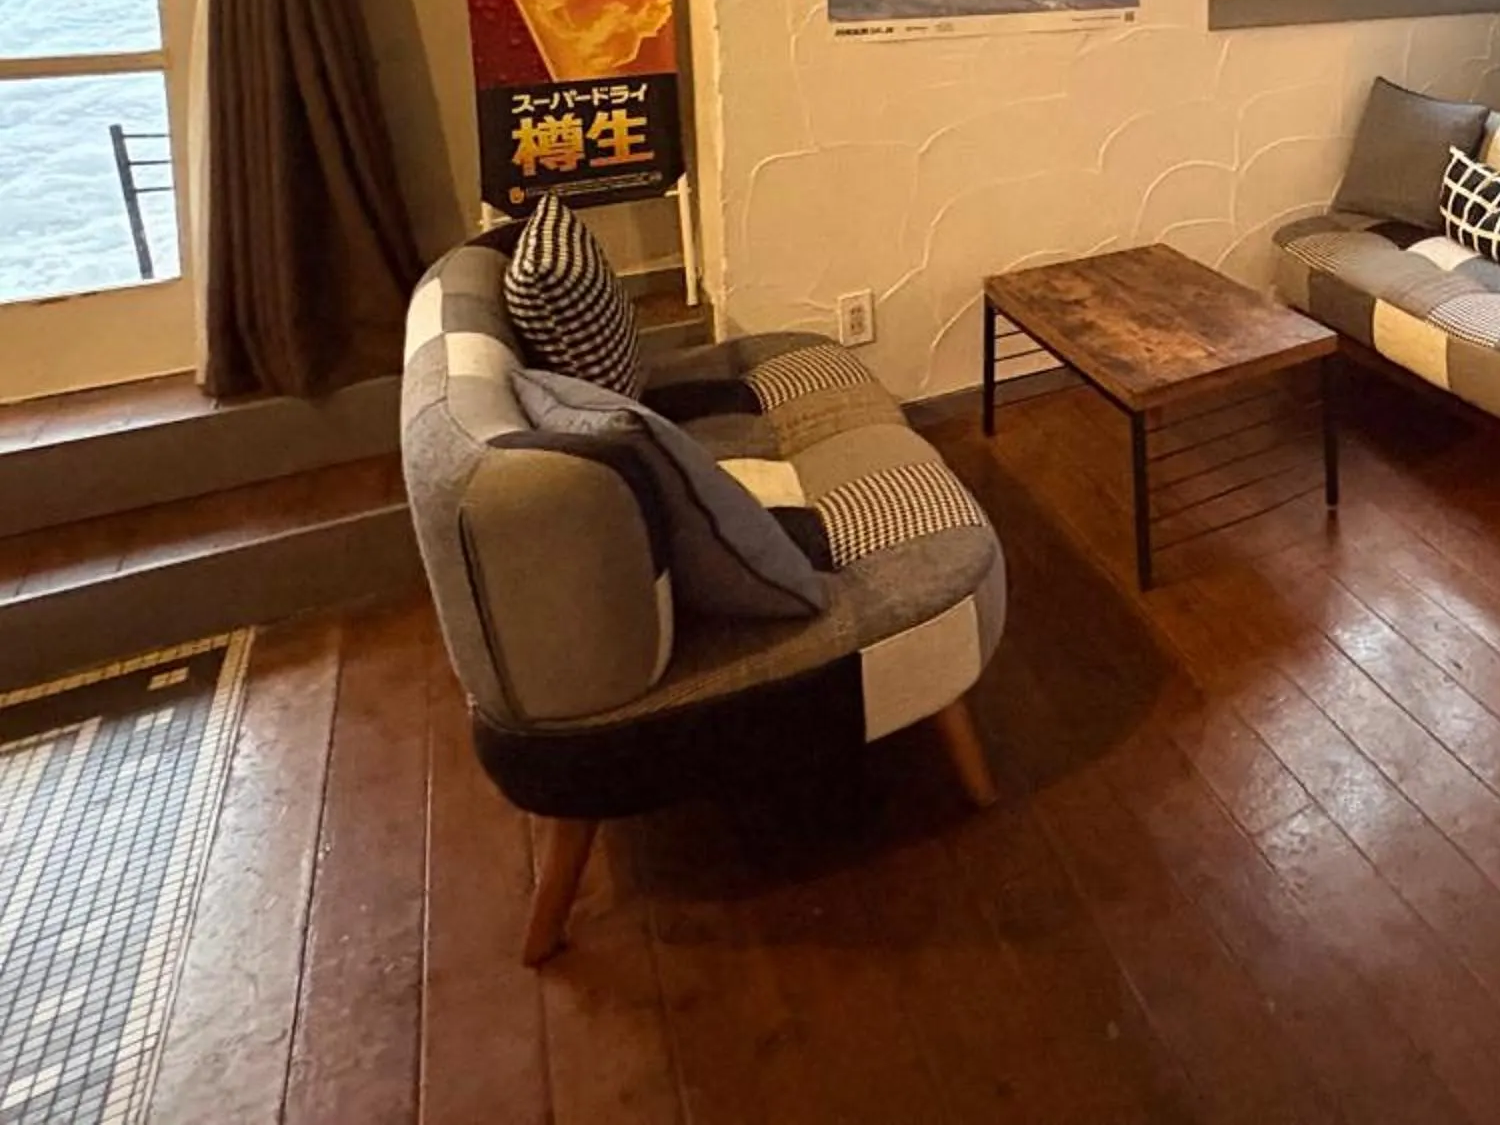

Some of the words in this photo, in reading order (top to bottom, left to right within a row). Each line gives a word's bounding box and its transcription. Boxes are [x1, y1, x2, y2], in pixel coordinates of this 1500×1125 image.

[511, 83, 648, 114] スーパードライ
[511, 108, 655, 176] 樽生
